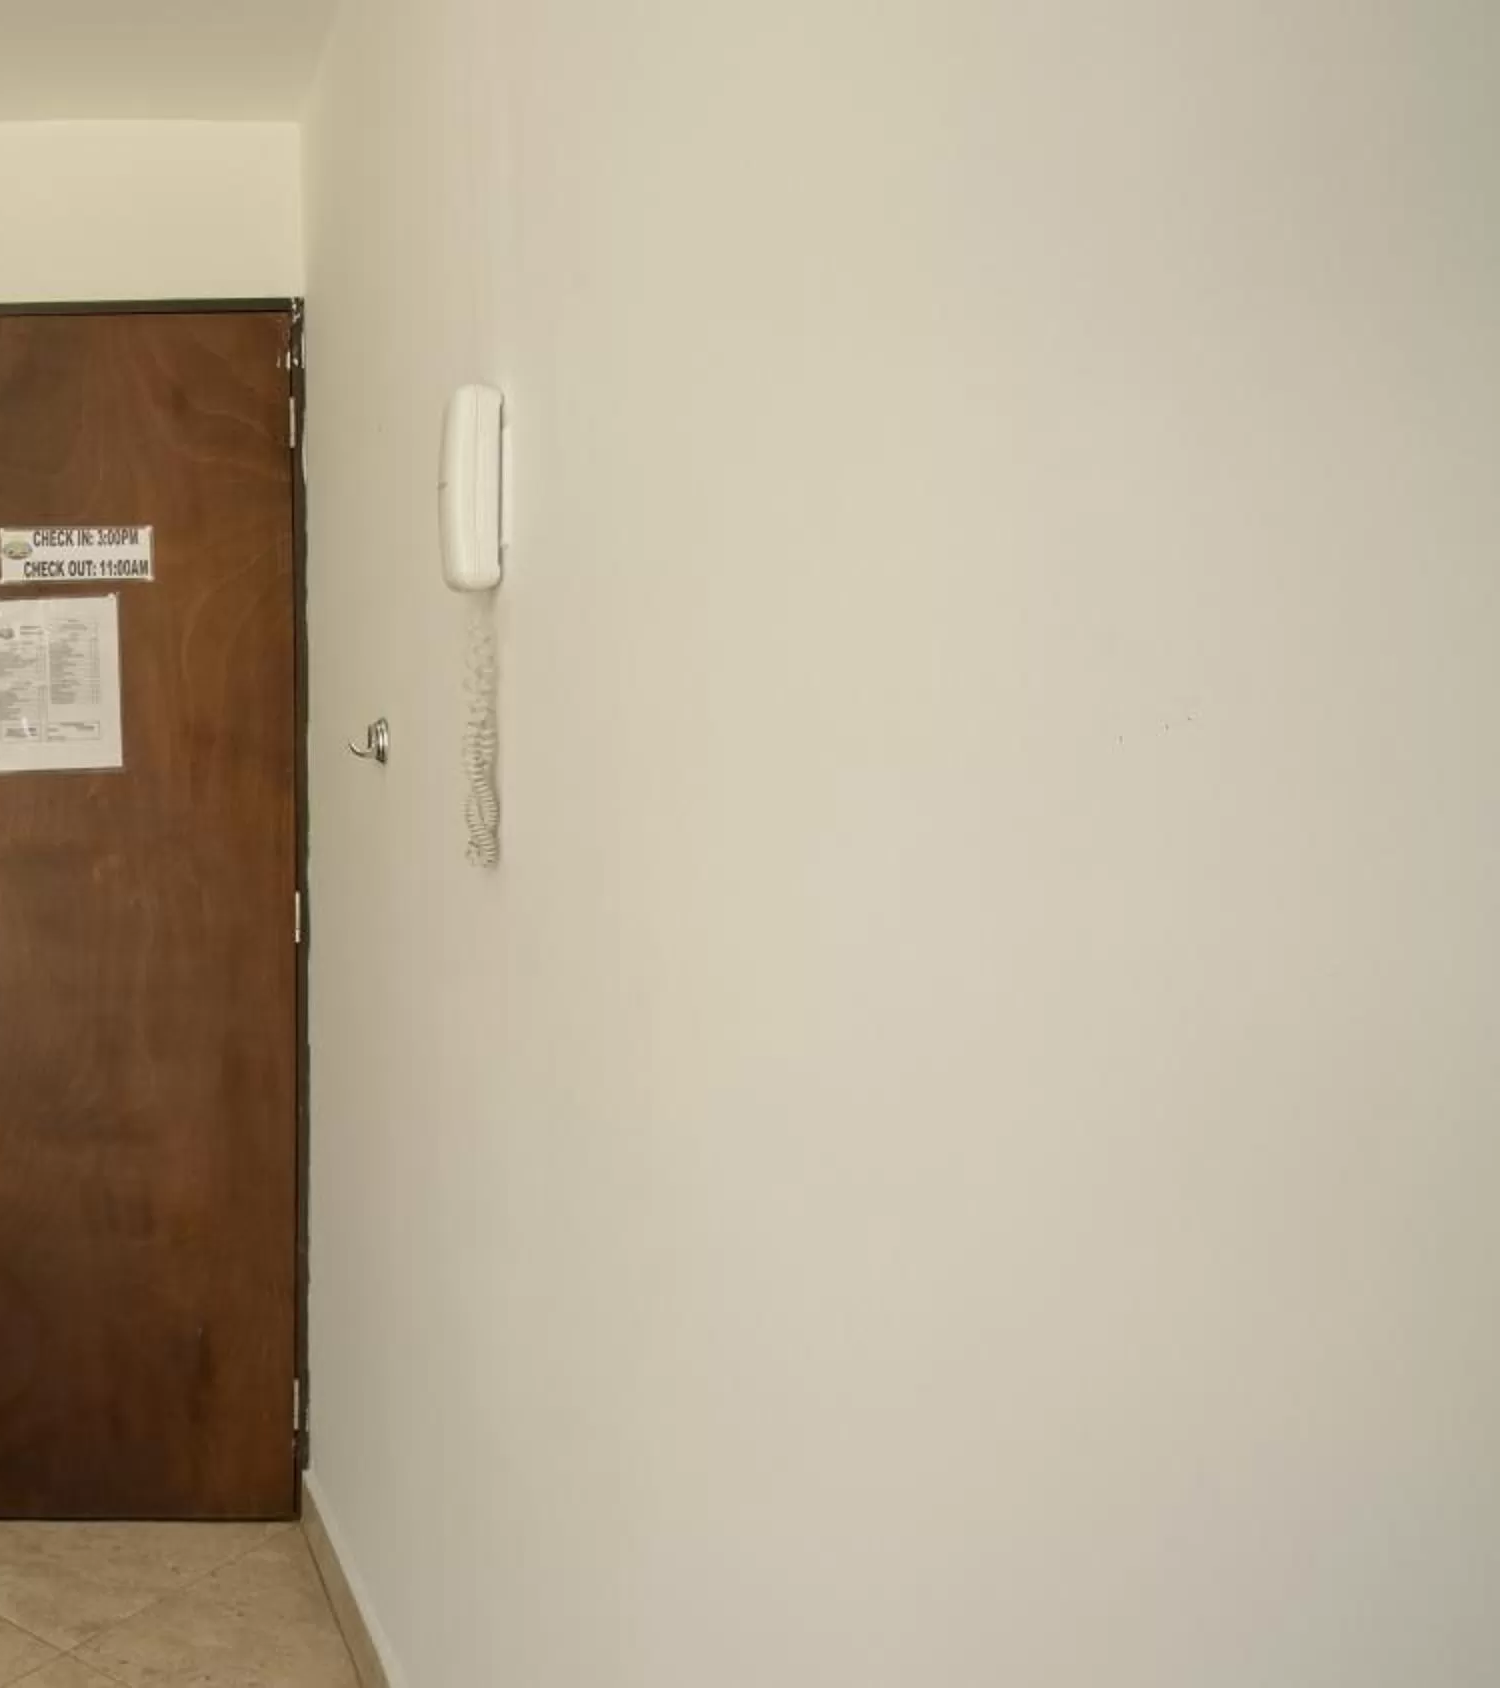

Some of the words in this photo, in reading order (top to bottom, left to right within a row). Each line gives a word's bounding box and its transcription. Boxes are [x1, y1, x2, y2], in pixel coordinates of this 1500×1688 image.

[33, 530, 74, 547] CHECK
[77, 530, 94, 546] IN:
[98, 528, 139, 546] 3:00PM
[24, 560, 65, 577] CHECK
[68, 560, 96, 576] OUT:
[100, 559, 148, 576] 11:00AM
